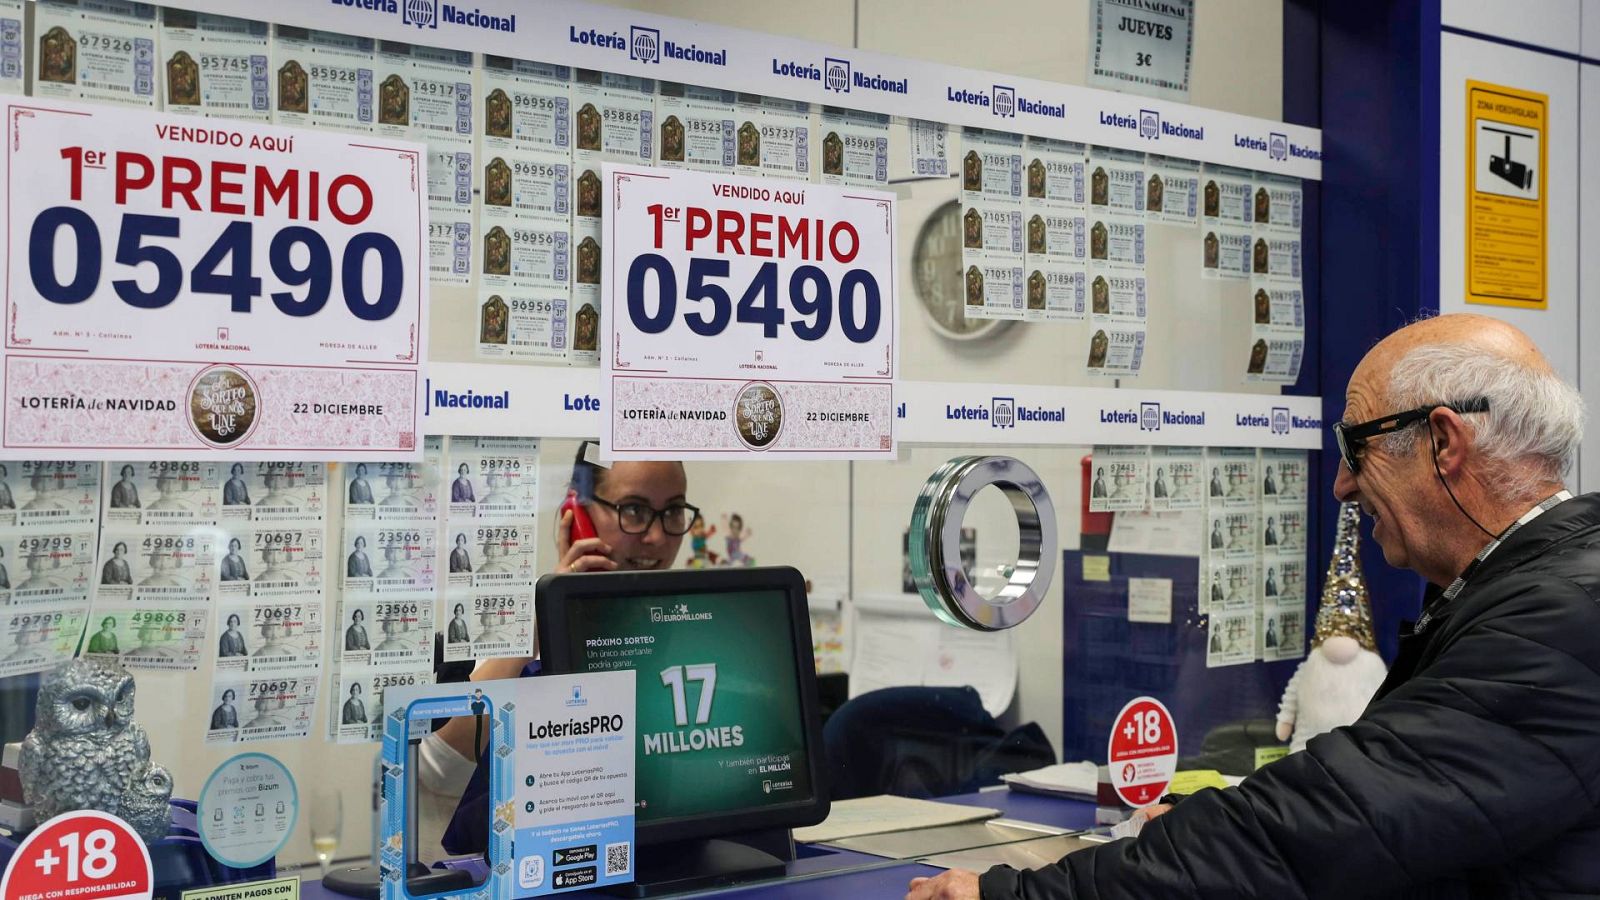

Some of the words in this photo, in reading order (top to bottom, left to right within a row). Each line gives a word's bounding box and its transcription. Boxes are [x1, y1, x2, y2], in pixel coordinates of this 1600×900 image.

[442, 4, 515, 33] Nacional
[1118, 16, 1173, 41] JUEVES
[80, 35, 132, 52] 67926
[570, 26, 626, 51] Lotería
[664, 41, 726, 66] Nacional
[201, 56, 249, 70] 95745
[1136, 52, 1152, 67] 3€
[311, 67, 356, 82] 85928
[773, 58, 821, 81] Lotería
[854, 72, 908, 94] Nacional
[413, 81, 455, 96] 14917
[514, 95, 555, 110] 96956
[948, 87, 990, 107] Lotería
[1018, 98, 1065, 118] Nacional
[603, 109, 640, 122] 85884
[688, 121, 721, 132] 18523
[1100, 111, 1137, 129] Lotería
[1162, 121, 1203, 140] Nacional
[156, 124, 242, 148] VENDIDO
[249, 134, 293, 153] AQUÍ
[761, 127, 795, 139] 05737
[845, 137, 876, 149] 85969
[1234, 134, 1268, 151] Lotería
[984, 155, 1010, 166] 71051
[515, 163, 554, 177] 96956
[60, 146, 107, 201] 1er
[115, 151, 374, 226] PREMIO
[712, 183, 771, 202] VENDIDO
[774, 189, 806, 206] AQUÍ
[984, 212, 1010, 222] 71051
[514, 231, 553, 245] 96956
[646, 203, 681, 249] 1er
[685, 206, 860, 264] PREMIO
[28, 205, 404, 321] 05490
[985, 269, 1011, 280] 71051
[627, 253, 881, 343] 05490
[512, 299, 551, 312] 96956
[195, 342, 219, 350] LOTERÍA
[220, 344, 251, 352] NACIONAL
[20, 394, 85, 410] LOTERÍA
[87, 398, 105, 411] de
[105, 398, 177, 411] NAVIDAD
[201, 387, 246, 409] SORTEO
[435, 390, 509, 409] Nacional
[565, 394, 600, 411] Lote
[293, 402, 311, 414] 22
[314, 402, 383, 416] DICIEMBRE
[623, 407, 666, 420] LOTERÍA
[667, 410, 679, 421] de
[680, 409, 727, 421] NAVIDAD
[947, 404, 989, 420] Lotería
[1017, 407, 1064, 422] Nacional
[807, 412, 817, 421] 22
[820, 412, 870, 422] DICIEMBRE
[1100, 409, 1137, 424] Lotería
[1163, 411, 1204, 426] Nacional
[1236, 413, 1269, 427] Lotería
[22, 461, 76, 471] 49799
[149, 461, 200, 472] 49868
[481, 459, 520, 470] 98736
[255, 532, 302, 545] 70697
[379, 531, 420, 543] 23566
[477, 528, 518, 539] 98736
[19, 537, 72, 550] 49799
[142, 537, 194, 549] 49868
[375, 604, 417, 615] 23566
[475, 598, 515, 608] 98736
[10, 612, 62, 626] 49799
[131, 612, 186, 623] 49868
[254, 606, 301, 619] 70697
[663, 611, 712, 622] EUROMILLONES
[586, 636, 622, 647] PRÓXIMO
[624, 635, 655, 645] SORTEO
[587, 650, 597, 659] Un
[598, 648, 619, 658] único
[620, 647, 652, 657] acertante
[250, 680, 297, 693] 70697
[373, 675, 414, 687] 23566
[660, 663, 717, 726] 17
[529, 714, 623, 740] LoteríasPRO
[1123, 710, 1161, 745] +18
[643, 725, 744, 756] MILLONES
[718, 760, 724, 768] Y
[726, 756, 755, 768] también
[756, 754, 790, 766] participas
[749, 767, 758, 775] en
[759, 765, 767, 773] EL
[767, 761, 791, 772] MILLÓN
[258, 783, 280, 792] Bizum
[35, 829, 117, 882] +18
[565, 852, 582, 862] Google
[582, 851, 595, 860] Play
[565, 877, 578, 885] App
[578, 874, 593, 883] Store
[46, 891, 63, 899] CON
[65, 880, 137, 896] RESPONSABILIDAD
[205, 889, 243, 900] ADMITEN
[245, 887, 273, 899] PAGOS
[274, 885, 292, 895] CON
